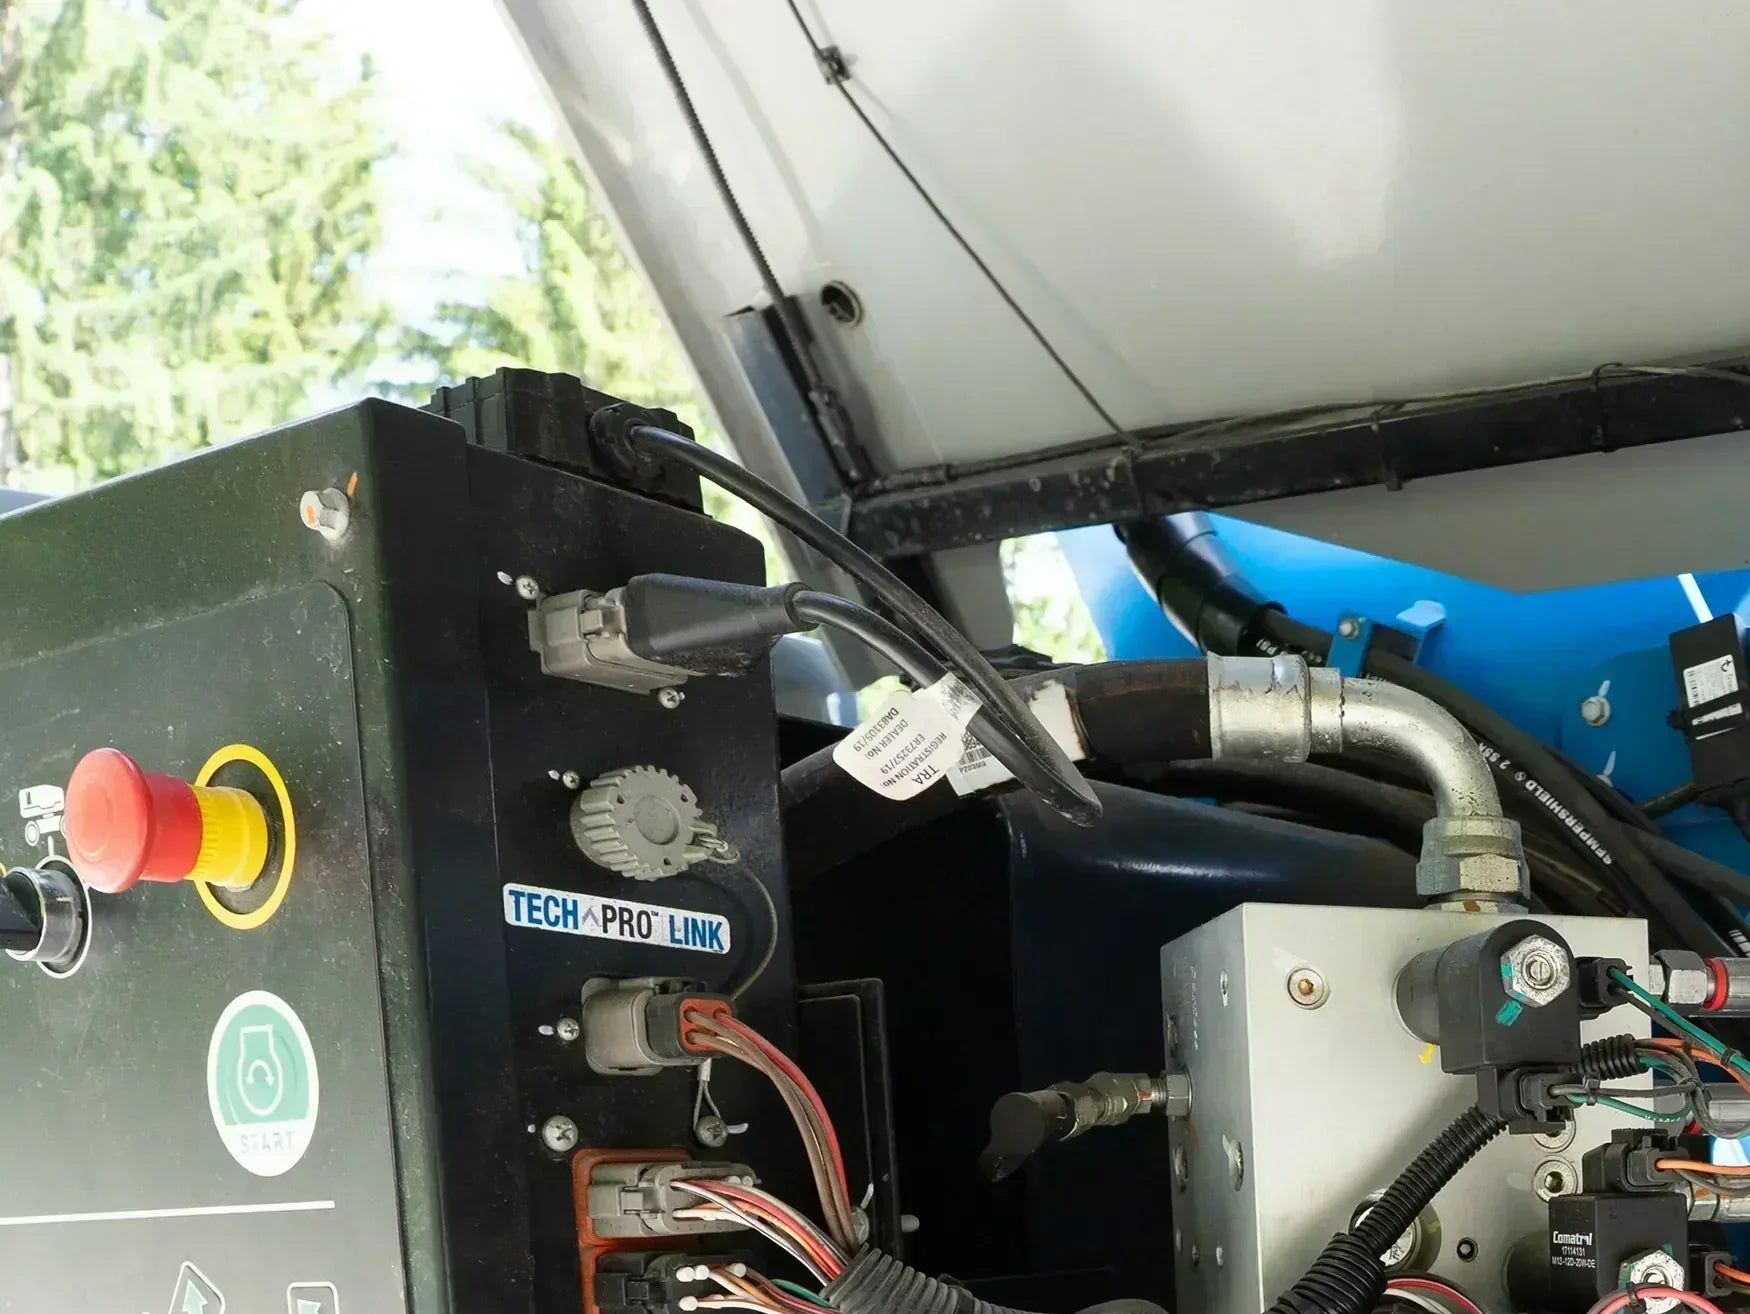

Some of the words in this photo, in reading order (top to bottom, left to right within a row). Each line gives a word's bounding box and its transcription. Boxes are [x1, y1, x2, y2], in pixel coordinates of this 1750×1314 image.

[880, 733, 926, 774] ER73257/19
[881, 718, 909, 752] DEALER
[896, 731, 947, 780] REGISTRATION
[912, 764, 940, 785] TRA
[508, 889, 579, 930] TECH
[669, 914, 724, 950] LINK
